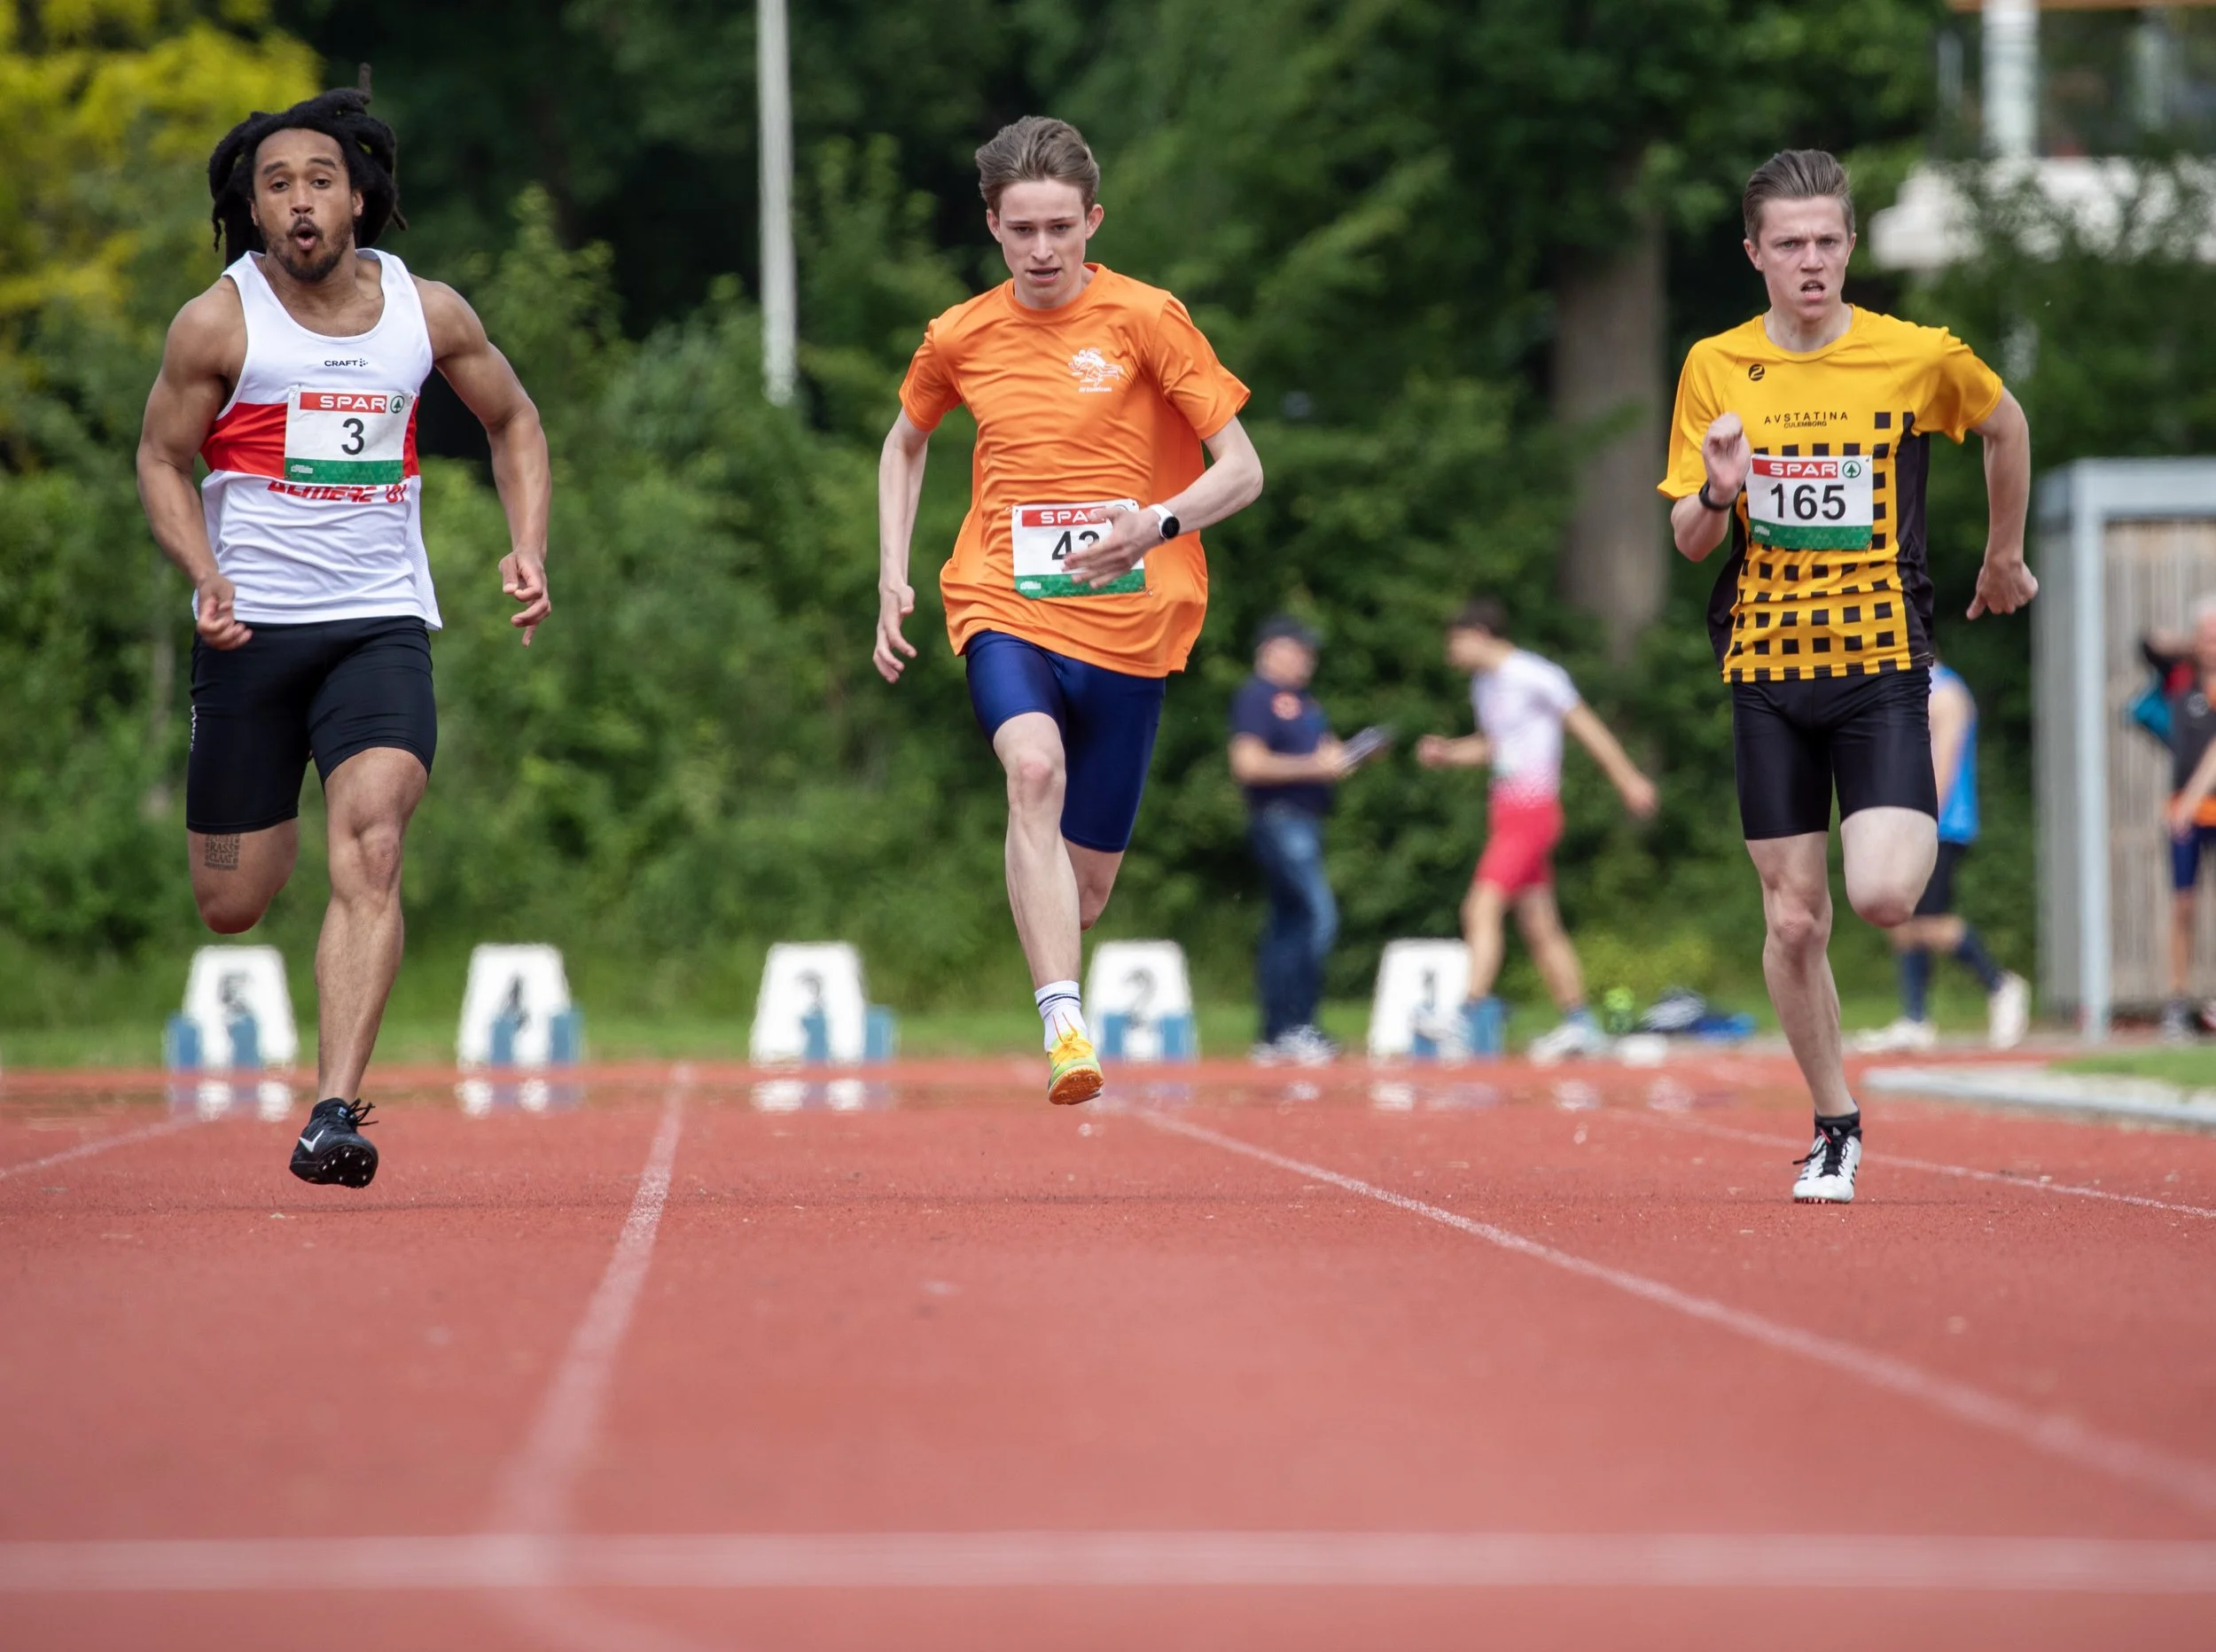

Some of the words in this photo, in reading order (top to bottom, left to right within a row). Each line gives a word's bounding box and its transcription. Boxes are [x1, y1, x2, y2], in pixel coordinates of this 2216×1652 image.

[319, 395, 386, 411] SPAR
[341, 417, 364, 456] 3
[1770, 463, 1837, 476] SPAR
[1770, 483, 1846, 520] 165
